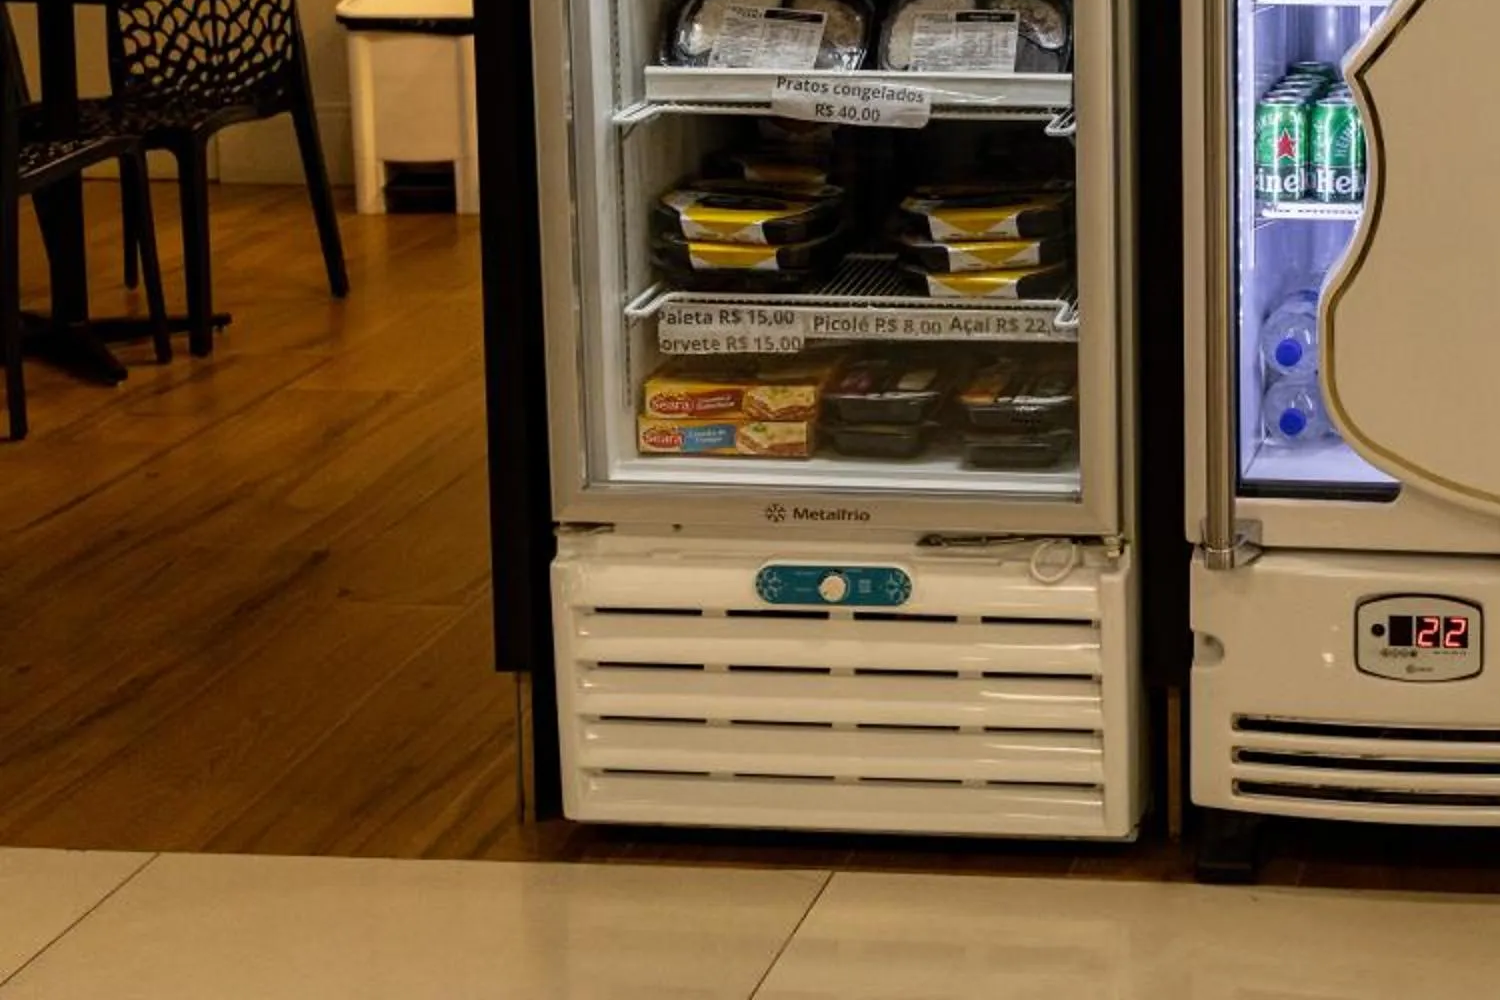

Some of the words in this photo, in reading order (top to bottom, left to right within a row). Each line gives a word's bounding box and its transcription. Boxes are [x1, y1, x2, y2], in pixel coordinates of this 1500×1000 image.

[776, 75, 829, 94] Pratos
[833, 83, 926, 104] congelados
[815, 102, 835, 118] R$
[837, 105, 881, 123] 40,00
[657, 309, 714, 326] Paleta
[718, 308, 742, 325] R$
[748, 308, 796, 327] 15,00
[812, 315, 869, 333] Picolé
[902, 319, 943, 337] 8,00
[660, 338, 722, 352] orvete
[753, 335, 802, 353] 15,00
[793, 505, 871, 521] Metalfrio
[1418, 617, 1467, 647] 22
